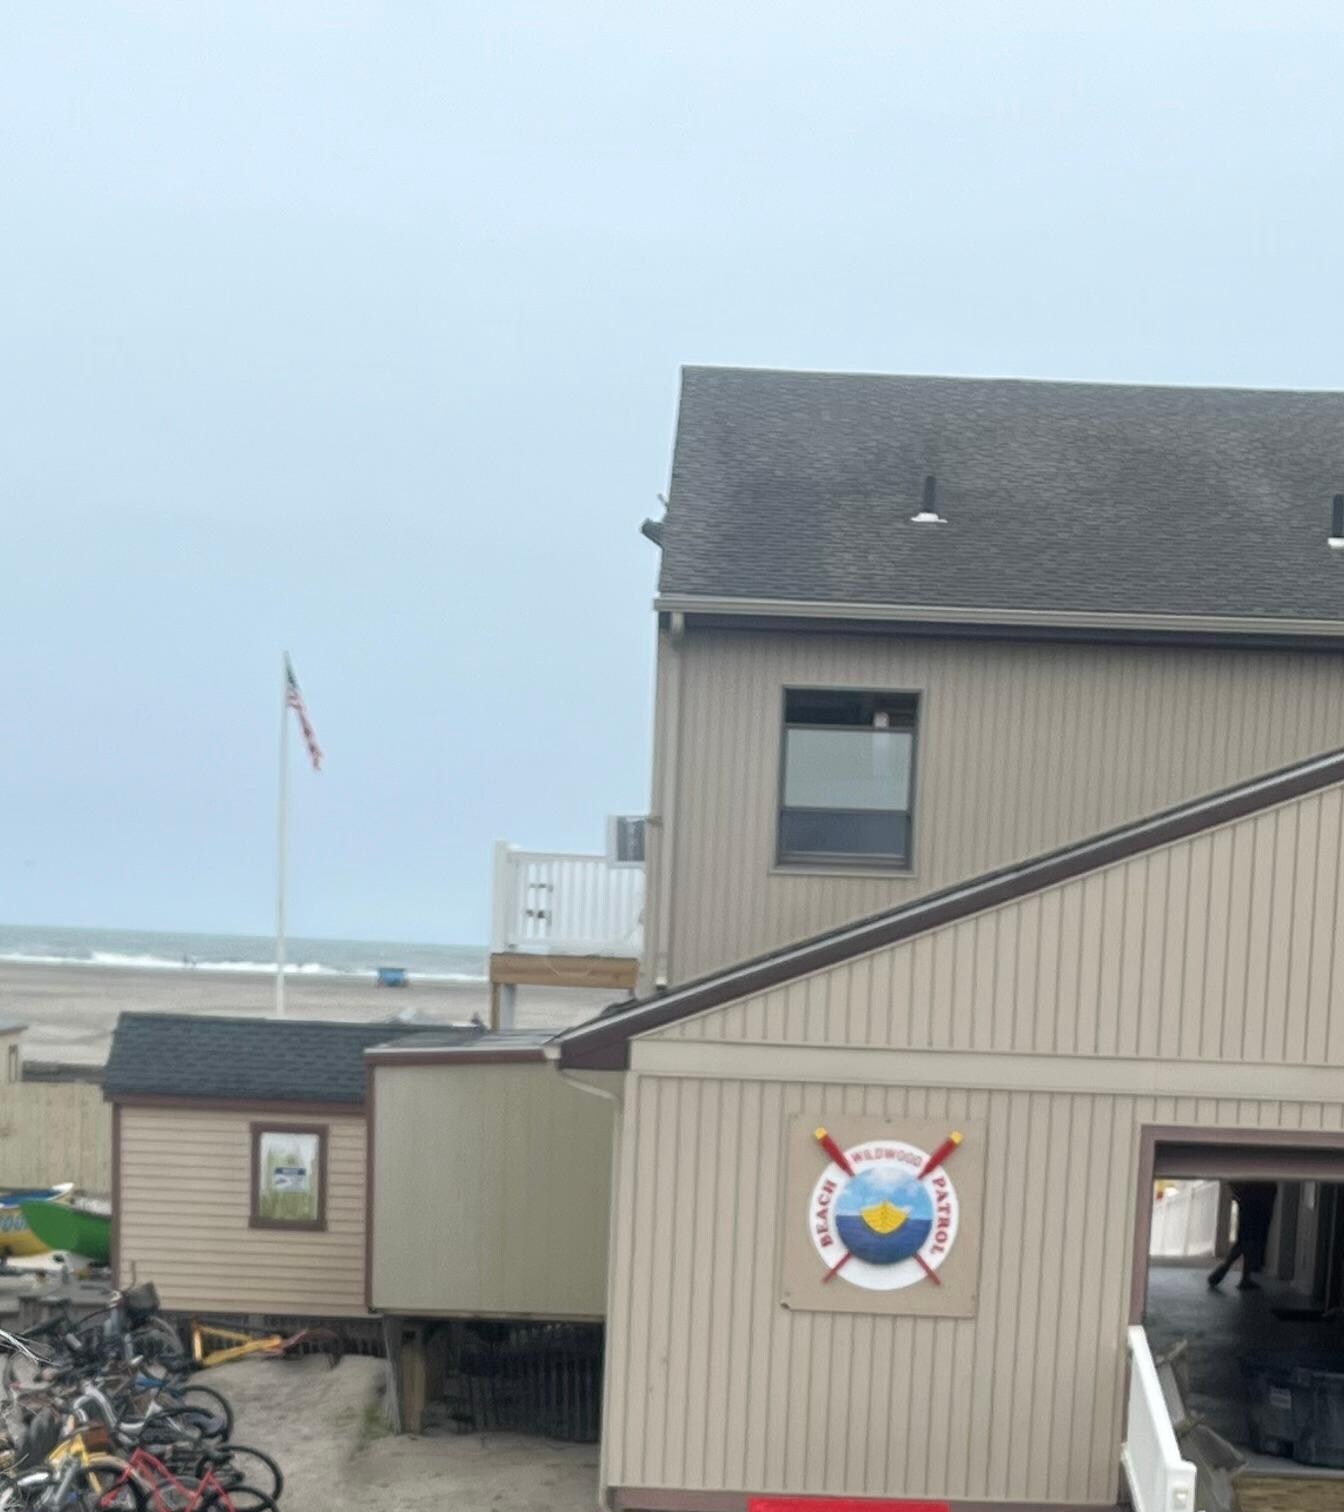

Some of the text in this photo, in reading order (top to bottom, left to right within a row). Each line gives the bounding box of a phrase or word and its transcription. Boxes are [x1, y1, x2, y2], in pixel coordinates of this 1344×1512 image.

[851, 1147, 923, 1168] WILDWOOD
[816, 1179, 837, 1248] BEACH
[931, 1176, 952, 1254] PATROL
